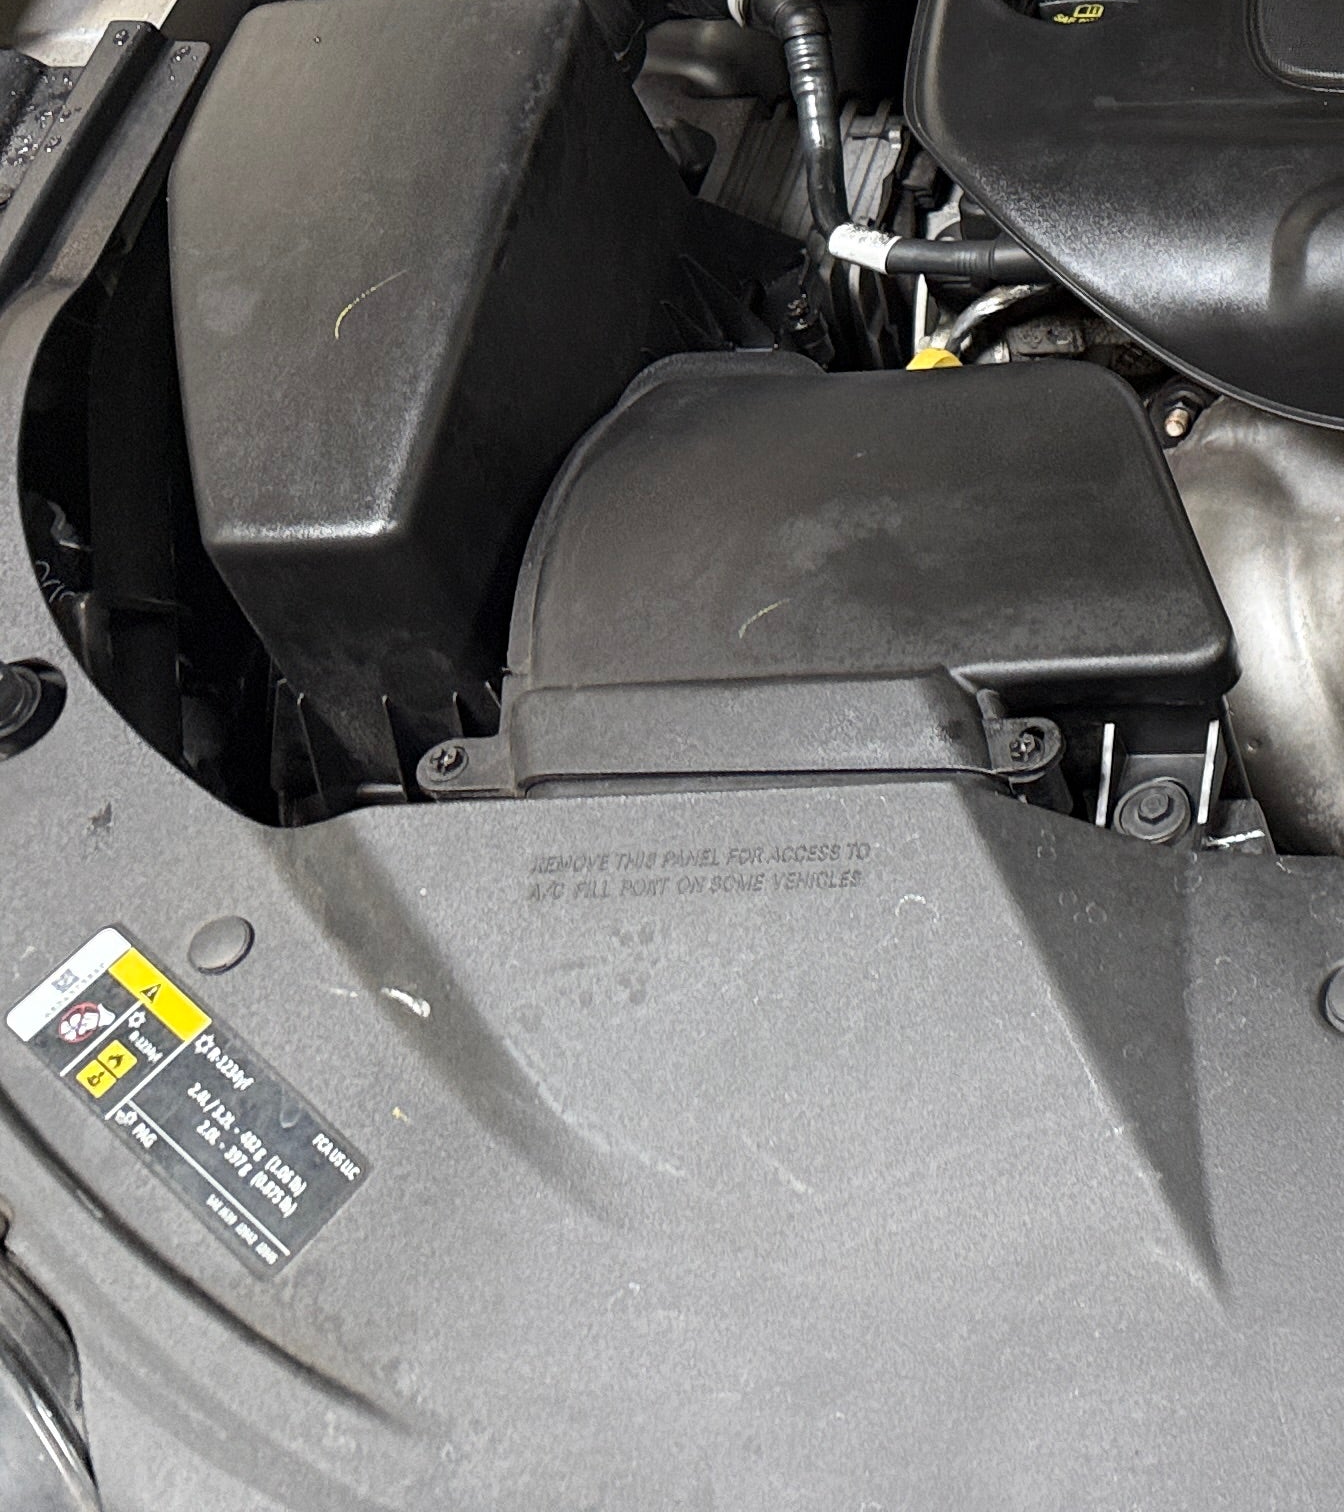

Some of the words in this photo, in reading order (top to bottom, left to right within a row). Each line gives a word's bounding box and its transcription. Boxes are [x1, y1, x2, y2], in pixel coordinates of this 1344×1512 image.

[531, 853, 609, 874] REMOVE
[616, 850, 656, 871] THIS
[661, 847, 720, 869] PANEL
[726, 846, 763, 866] FOR
[765, 842, 841, 864] ACCESS
[846, 841, 872, 861] TO
[573, 878, 610, 899] FILL
[675, 875, 704, 895] ON
[708, 871, 764, 894] SOME
[771, 869, 862, 890] VEHICLES
[132, 1123, 157, 1148] PAG
[224, 1145, 248, 1172] 397
[312, 1133, 337, 1156] FCA
[329, 1148, 348, 1167] US
[340, 1159, 360, 1180] LLC
